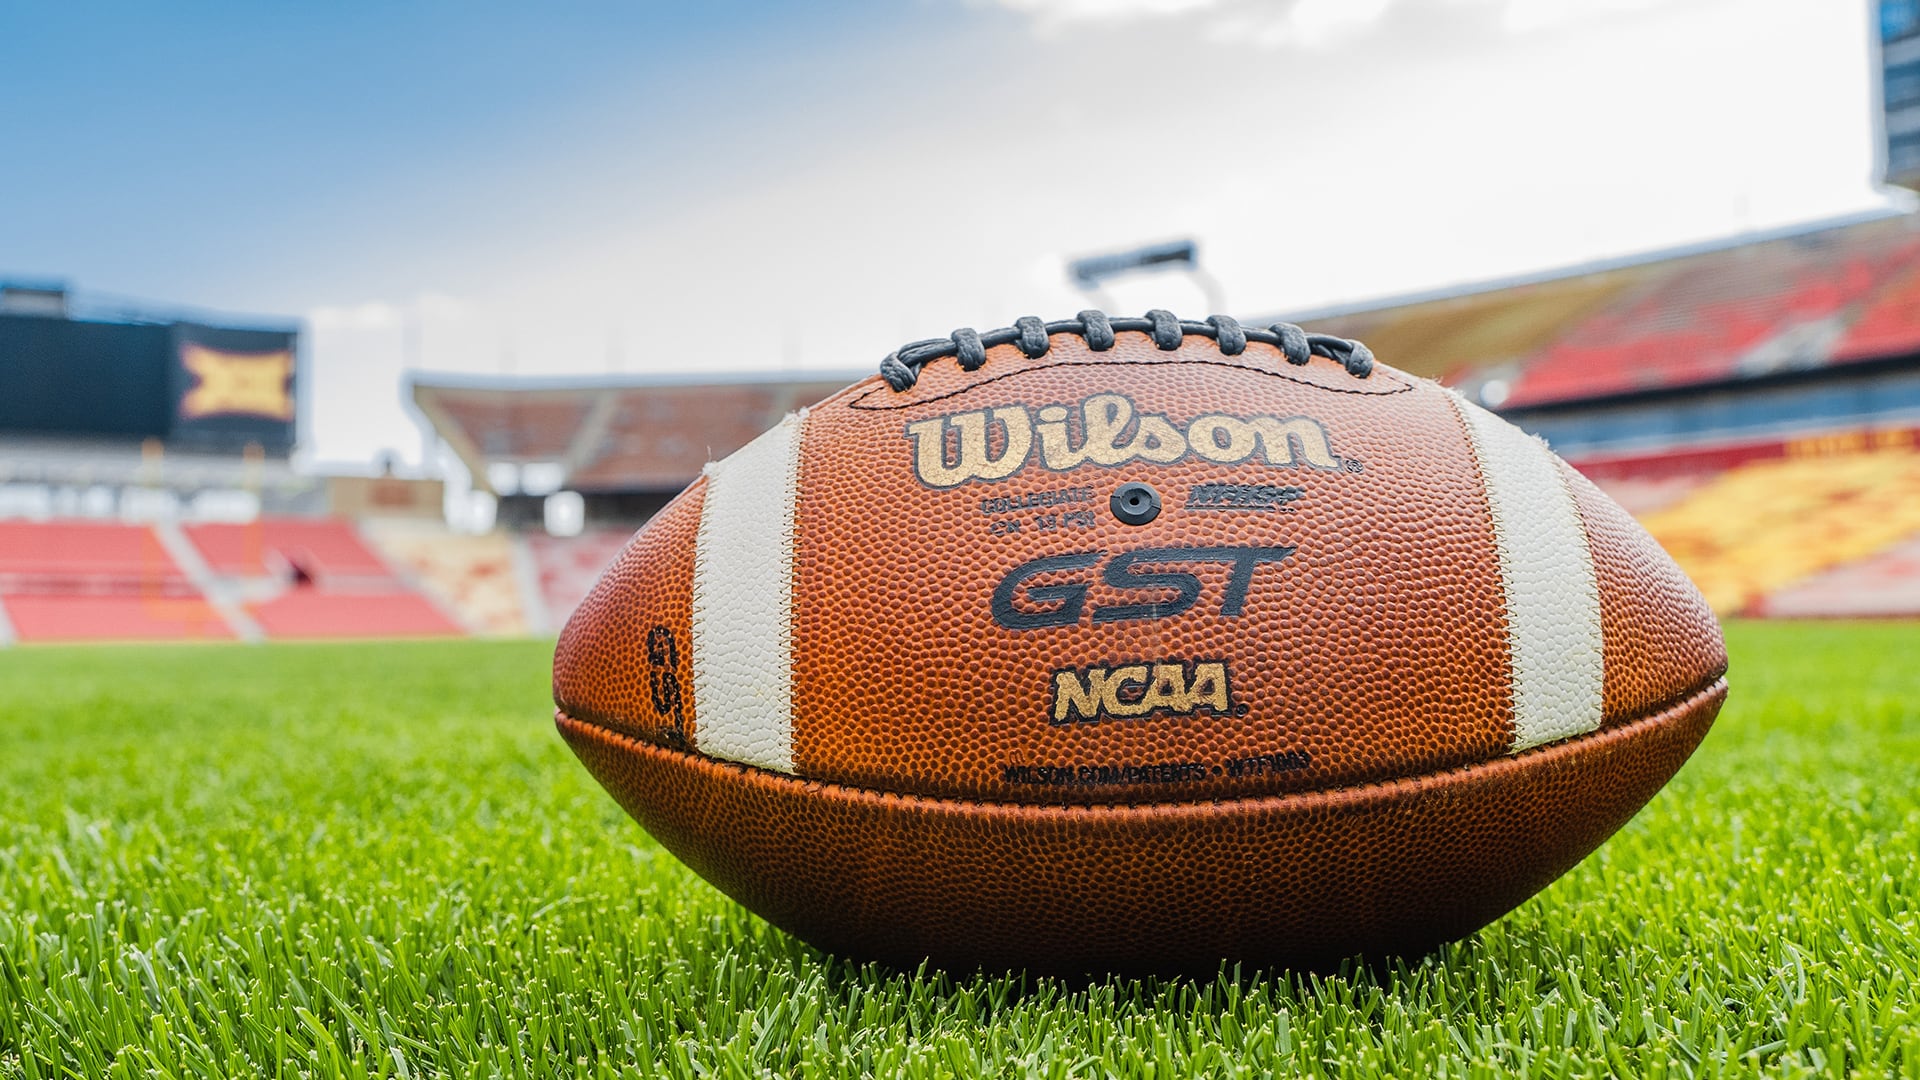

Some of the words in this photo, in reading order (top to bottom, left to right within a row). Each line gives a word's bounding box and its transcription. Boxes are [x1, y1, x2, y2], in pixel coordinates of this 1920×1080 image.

[905, 391, 1341, 490] Wilson
[981, 485, 1096, 515] COLLEGIATE
[1063, 510, 1096, 530] PSI
[991, 546, 1297, 632] GST
[1050, 659, 1232, 727] NCAA
